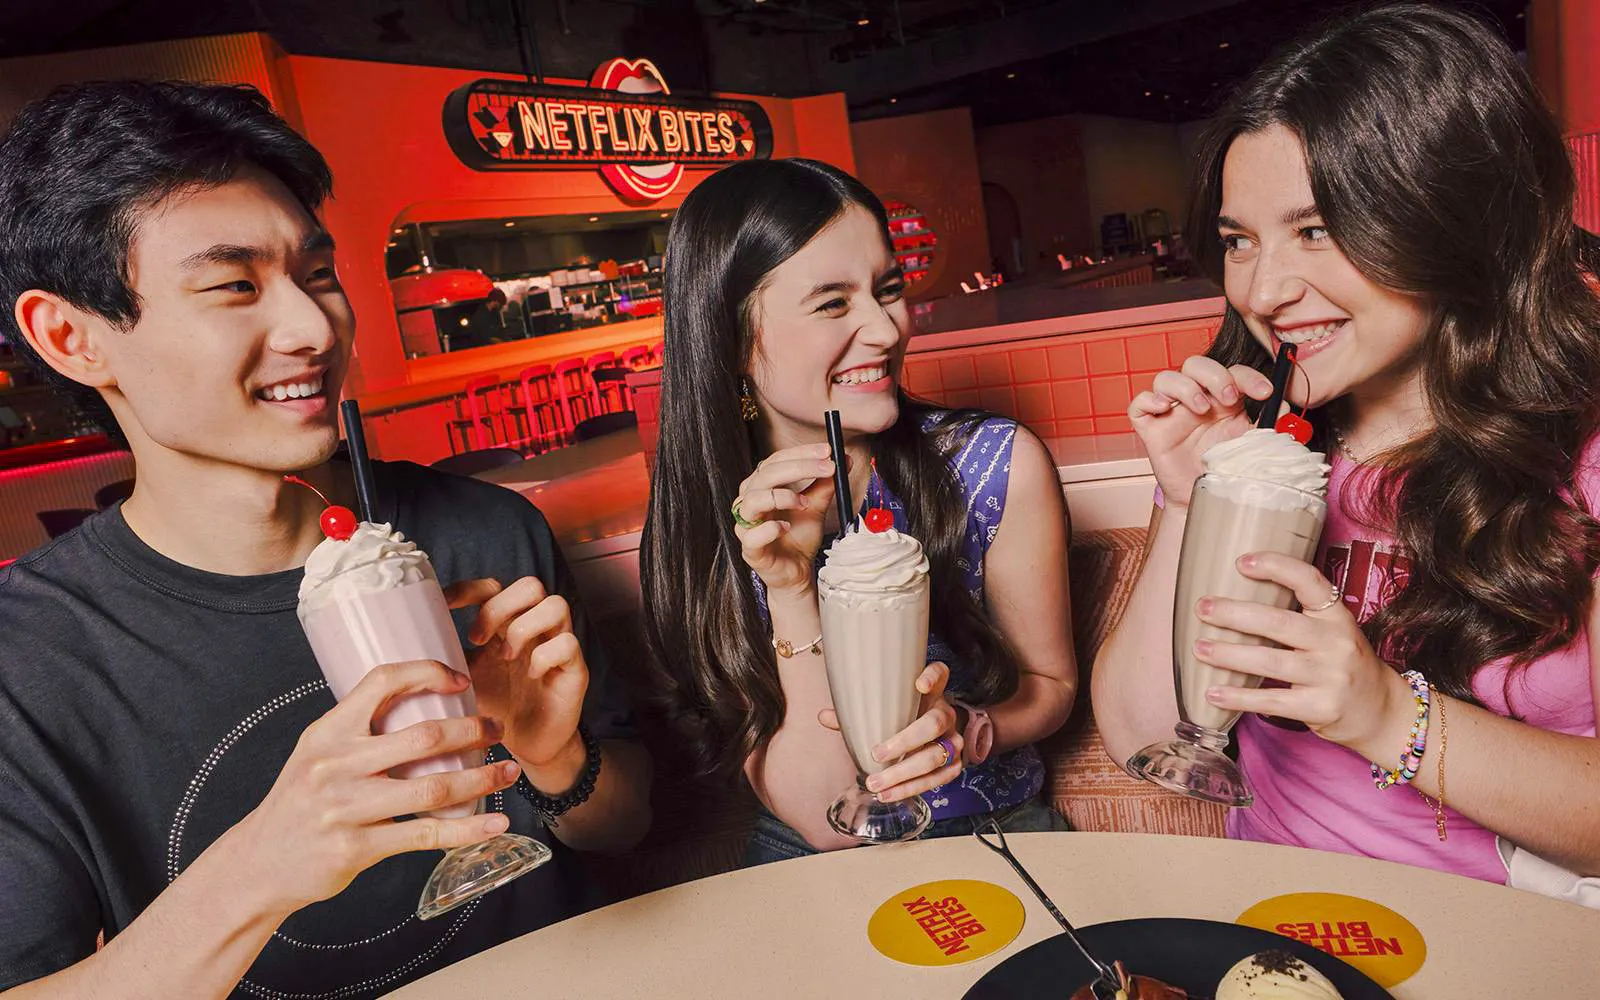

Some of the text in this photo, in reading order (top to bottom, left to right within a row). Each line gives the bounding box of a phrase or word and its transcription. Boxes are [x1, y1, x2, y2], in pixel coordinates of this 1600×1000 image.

[518, 101, 736, 153] NETFLIX BITES
[902, 896, 970, 956] NETFLIX
[934, 896, 986, 938] BITES
[1276, 921, 1373, 940] BITES
[1296, 938, 1403, 956] NETF
